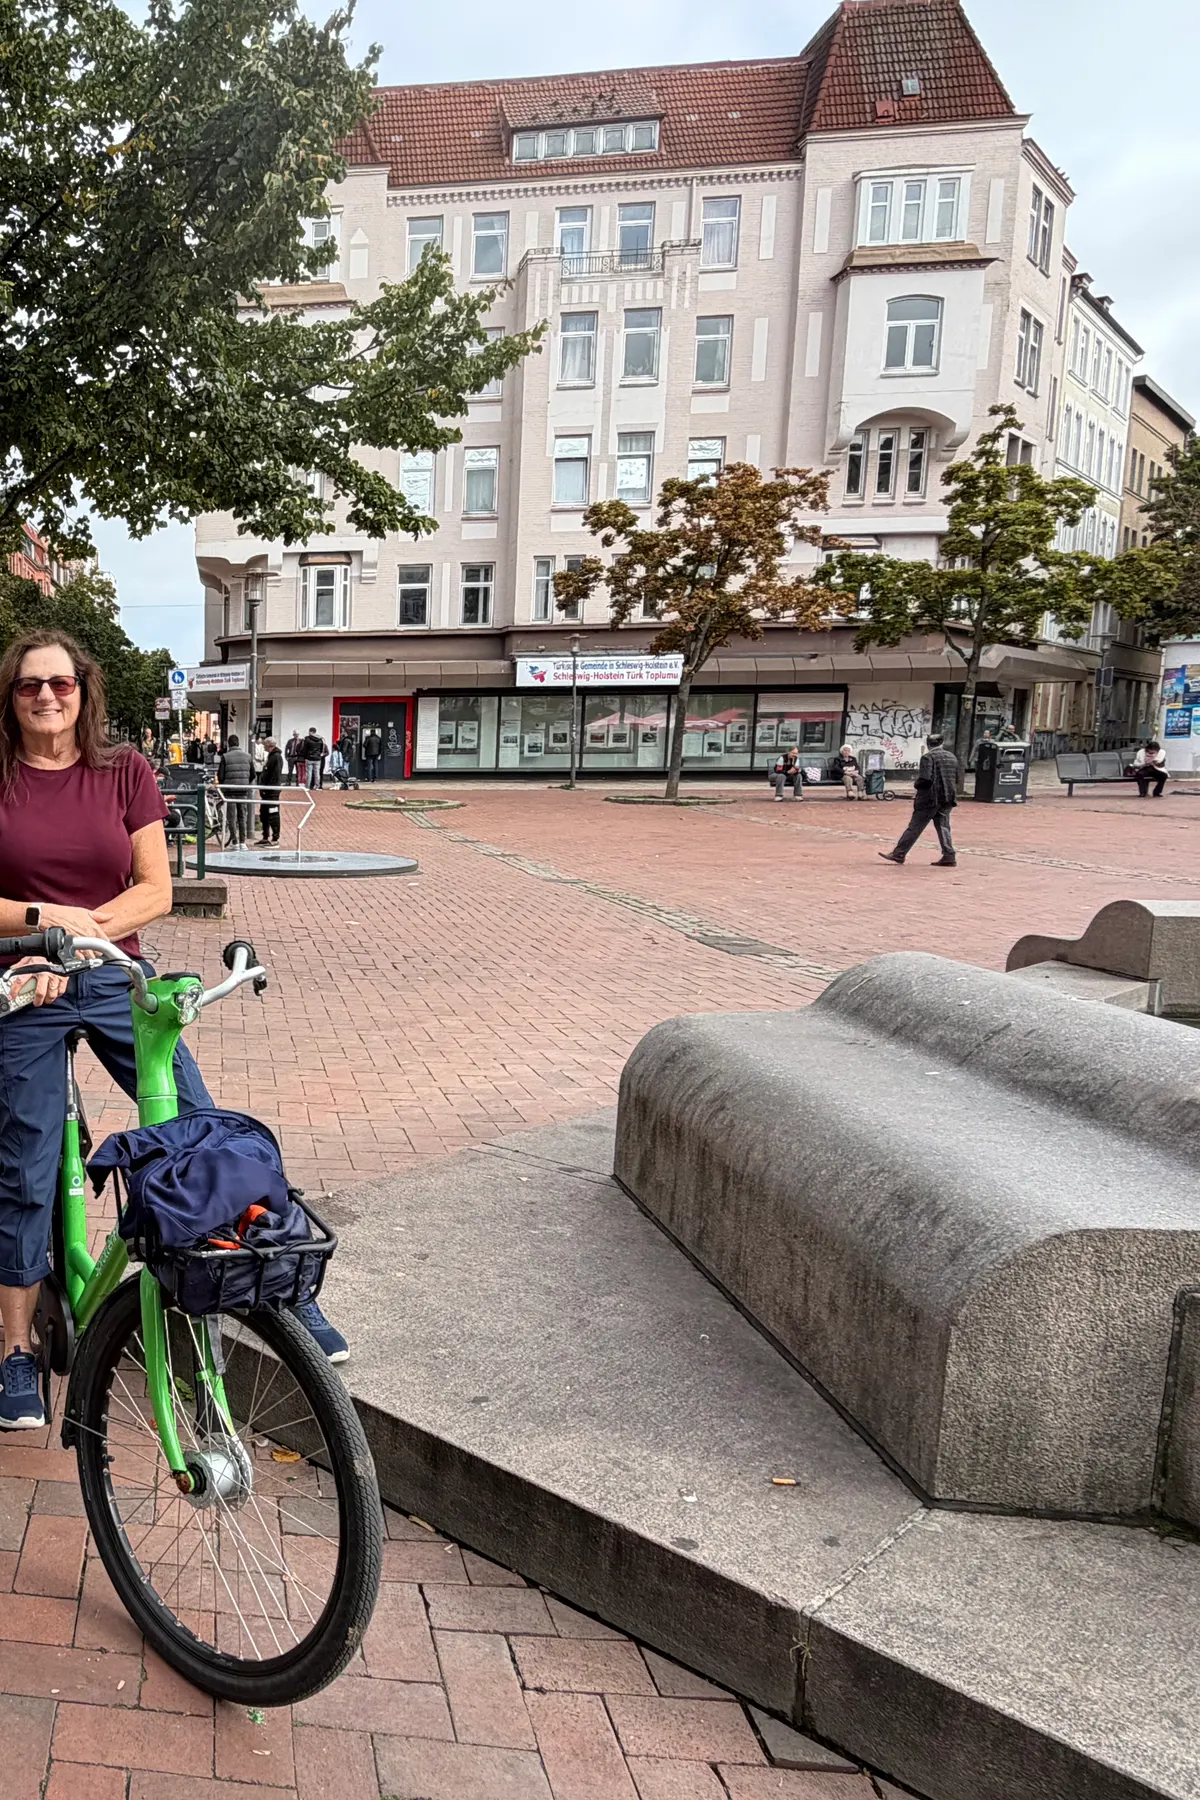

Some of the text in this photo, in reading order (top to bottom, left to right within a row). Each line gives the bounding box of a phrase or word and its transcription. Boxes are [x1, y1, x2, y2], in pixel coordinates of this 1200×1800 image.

[553, 661, 579, 670] Türkisce
[580, 662, 608, 670] Gemeinde
[609, 662, 615, 670] in
[626, 671, 644, 680] Türk
[645, 671, 679, 681] Toplumu
